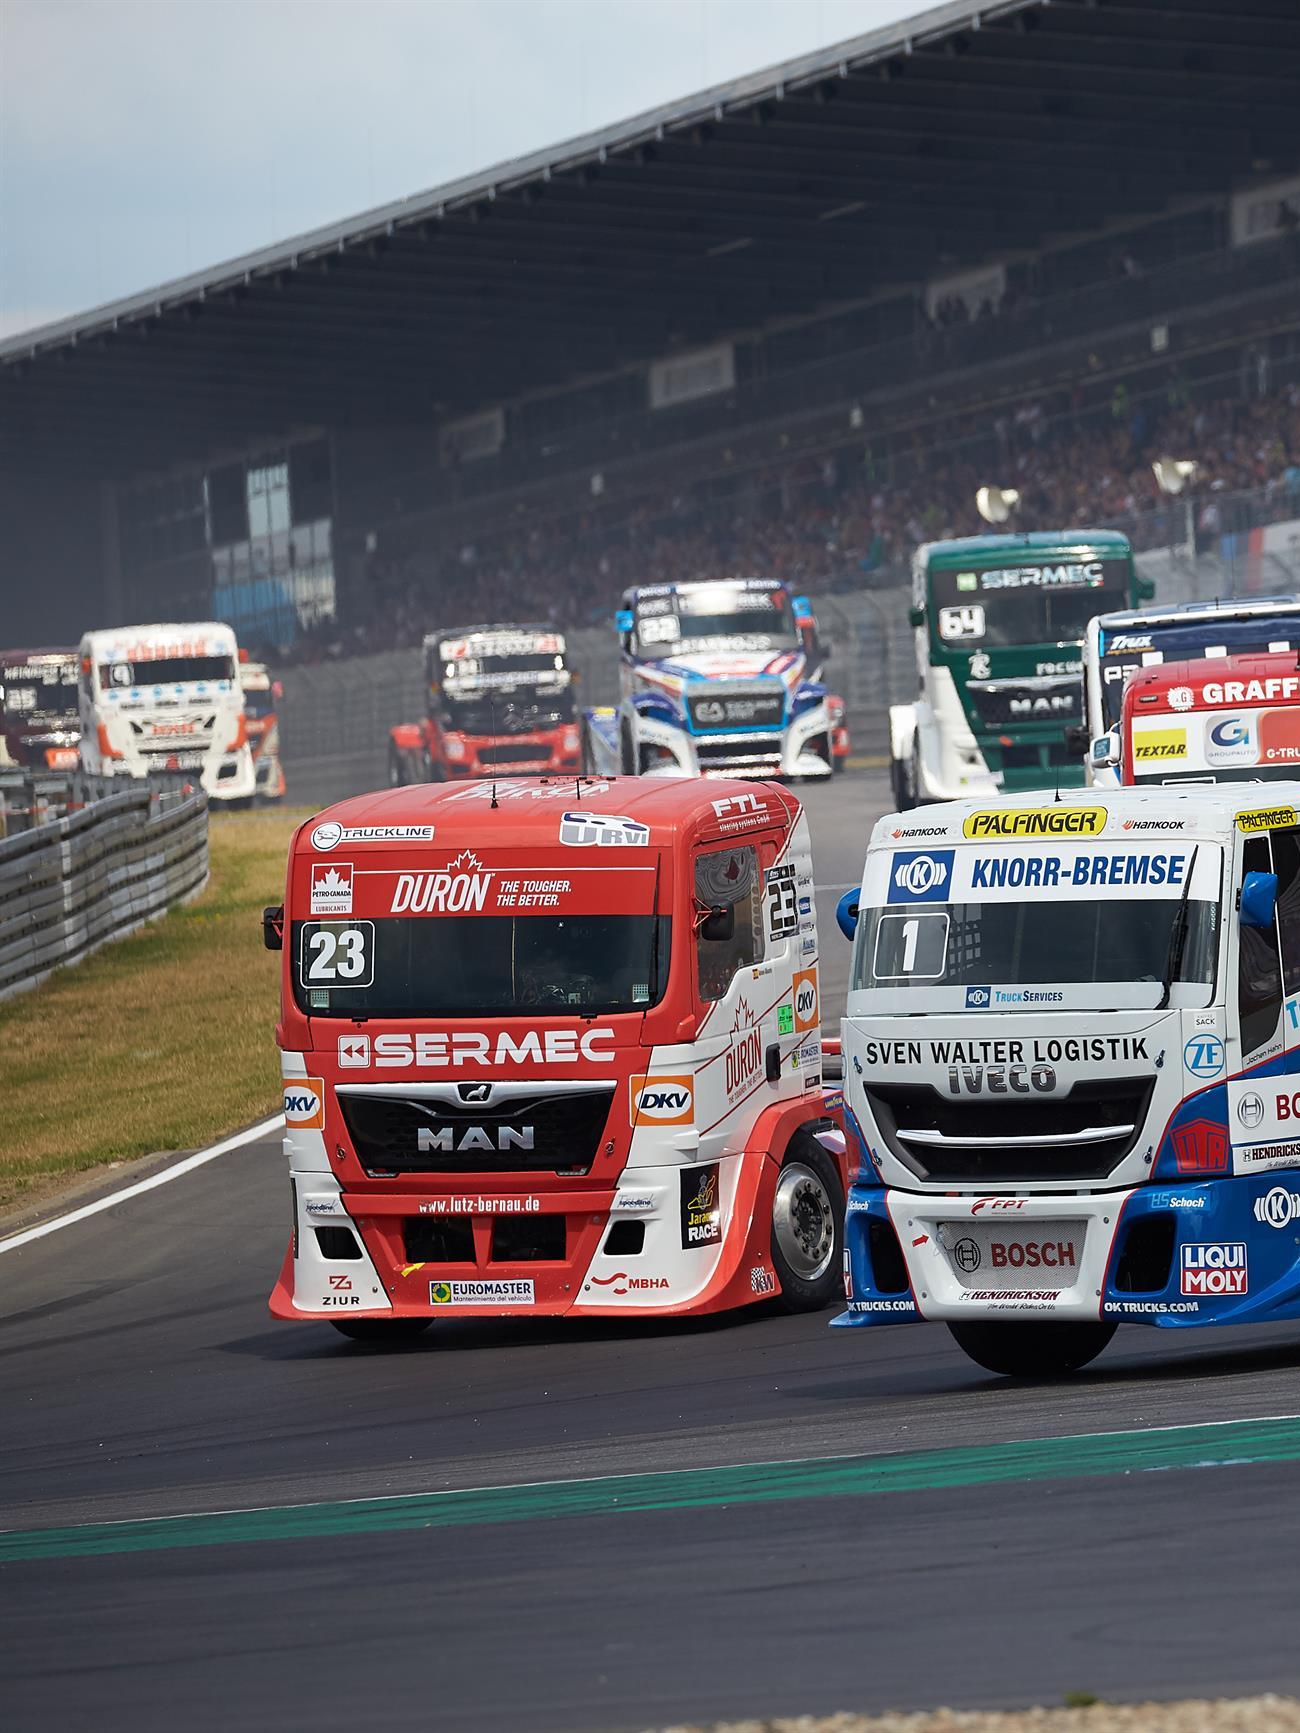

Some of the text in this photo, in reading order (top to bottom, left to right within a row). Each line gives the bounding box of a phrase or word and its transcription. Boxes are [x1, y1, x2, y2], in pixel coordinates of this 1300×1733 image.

[981, 563, 1104, 589] SERMEC
[1136, 744, 1186, 758] TEXTAR
[710, 793, 767, 818] FTL
[343, 827, 432, 838] TRUCKLINE
[971, 812, 1097, 835] PALFINGER
[971, 854, 1185, 889] KNORR-BREMSE
[390, 873, 493, 913] DURON
[500, 880, 572, 892] THE TOUGHER.
[496, 894, 560, 906] THE BETTER.
[308, 929, 366, 980] 23
[902, 920, 919, 972] 1
[798, 990, 814, 1012] DKV
[374, 1028, 615, 1067] SERMEC
[866, 1038, 1149, 1064] SVEN WALTER LOGISTIK
[1186, 1043, 1222, 1069] ZF
[727, 1025, 762, 1095] DURON
[948, 1064, 1057, 1094] IVECO
[641, 1092, 689, 1109] DKV
[418, 1126, 535, 1151] MAN
[419, 1195, 540, 1213] www.lutz-bernau.de
[991, 1200, 1029, 1209] FPT
[1169, 1197, 1204, 1208] Schoch
[688, 1222, 719, 1241] RACE
[991, 1241, 1076, 1267] BOSCH
[1185, 1245, 1244, 1269] LIQUI
[453, 1282, 532, 1295] EUROMASTER
[628, 1278, 670, 1288] MBHA
[1185, 1270, 1246, 1292] MOLY
[322, 1297, 360, 1305] ZIUR
[855, 1301, 915, 1311] TRUCKS.COM
[970, 1290, 1061, 1300] HENDRICKSON
[1104, 1301, 1199, 1313] OK TRUCKS.COM
